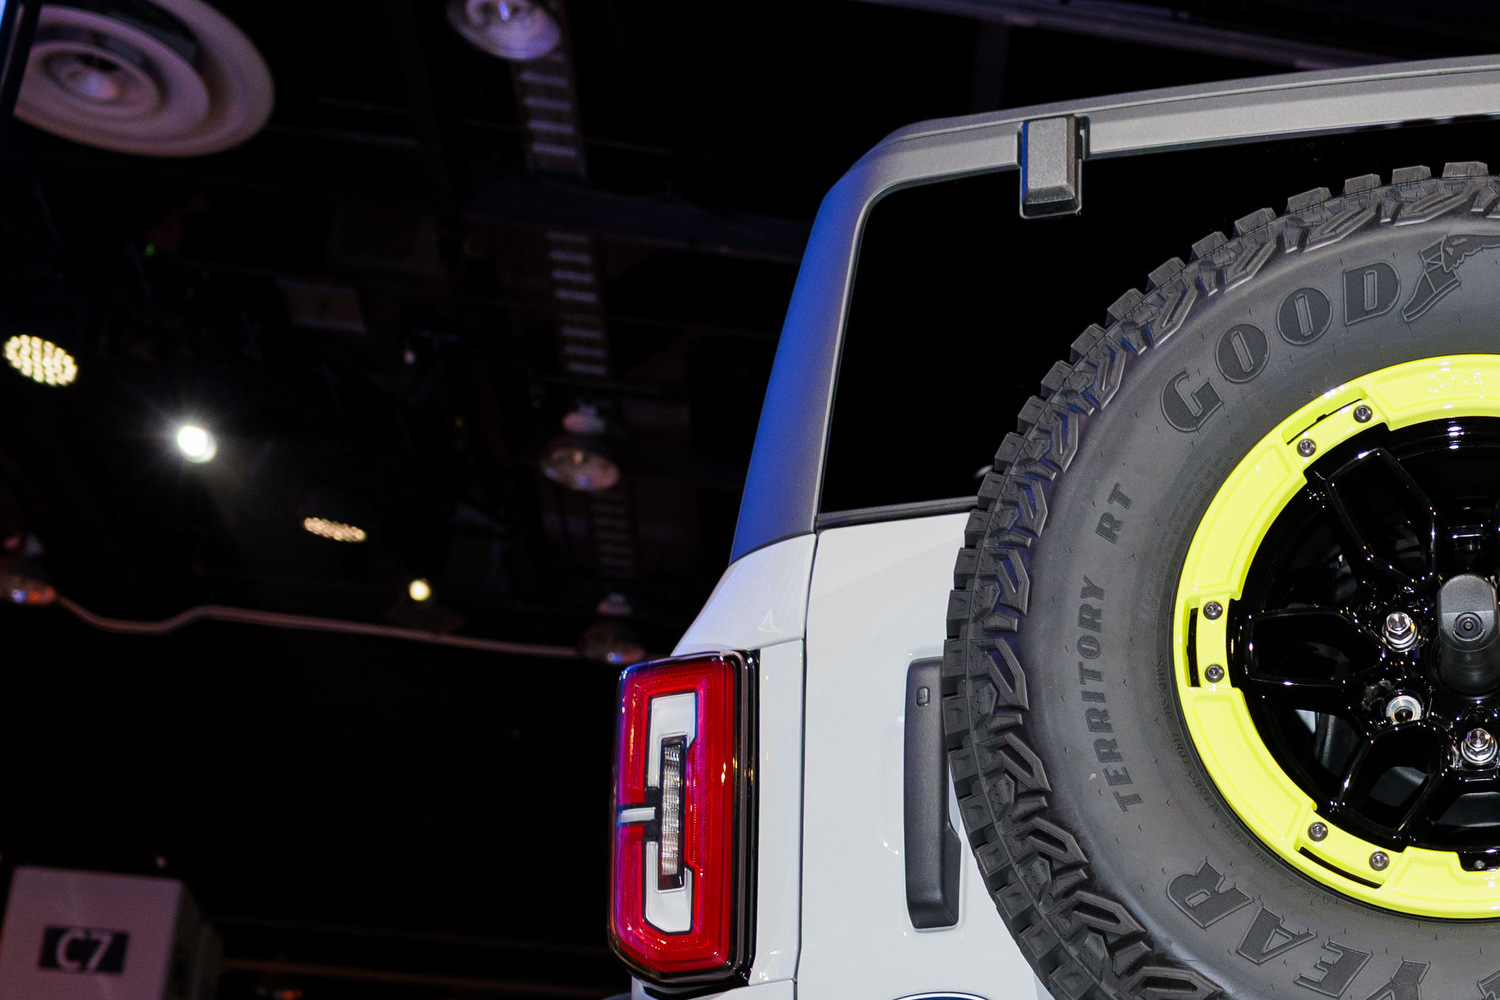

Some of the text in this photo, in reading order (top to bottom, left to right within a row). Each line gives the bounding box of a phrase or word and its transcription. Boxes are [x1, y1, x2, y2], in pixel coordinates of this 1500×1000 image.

[1160, 262, 1401, 433] GOOD
[1076, 482, 1144, 813] TERRITORY RT
[55, 928, 113, 973] C7
